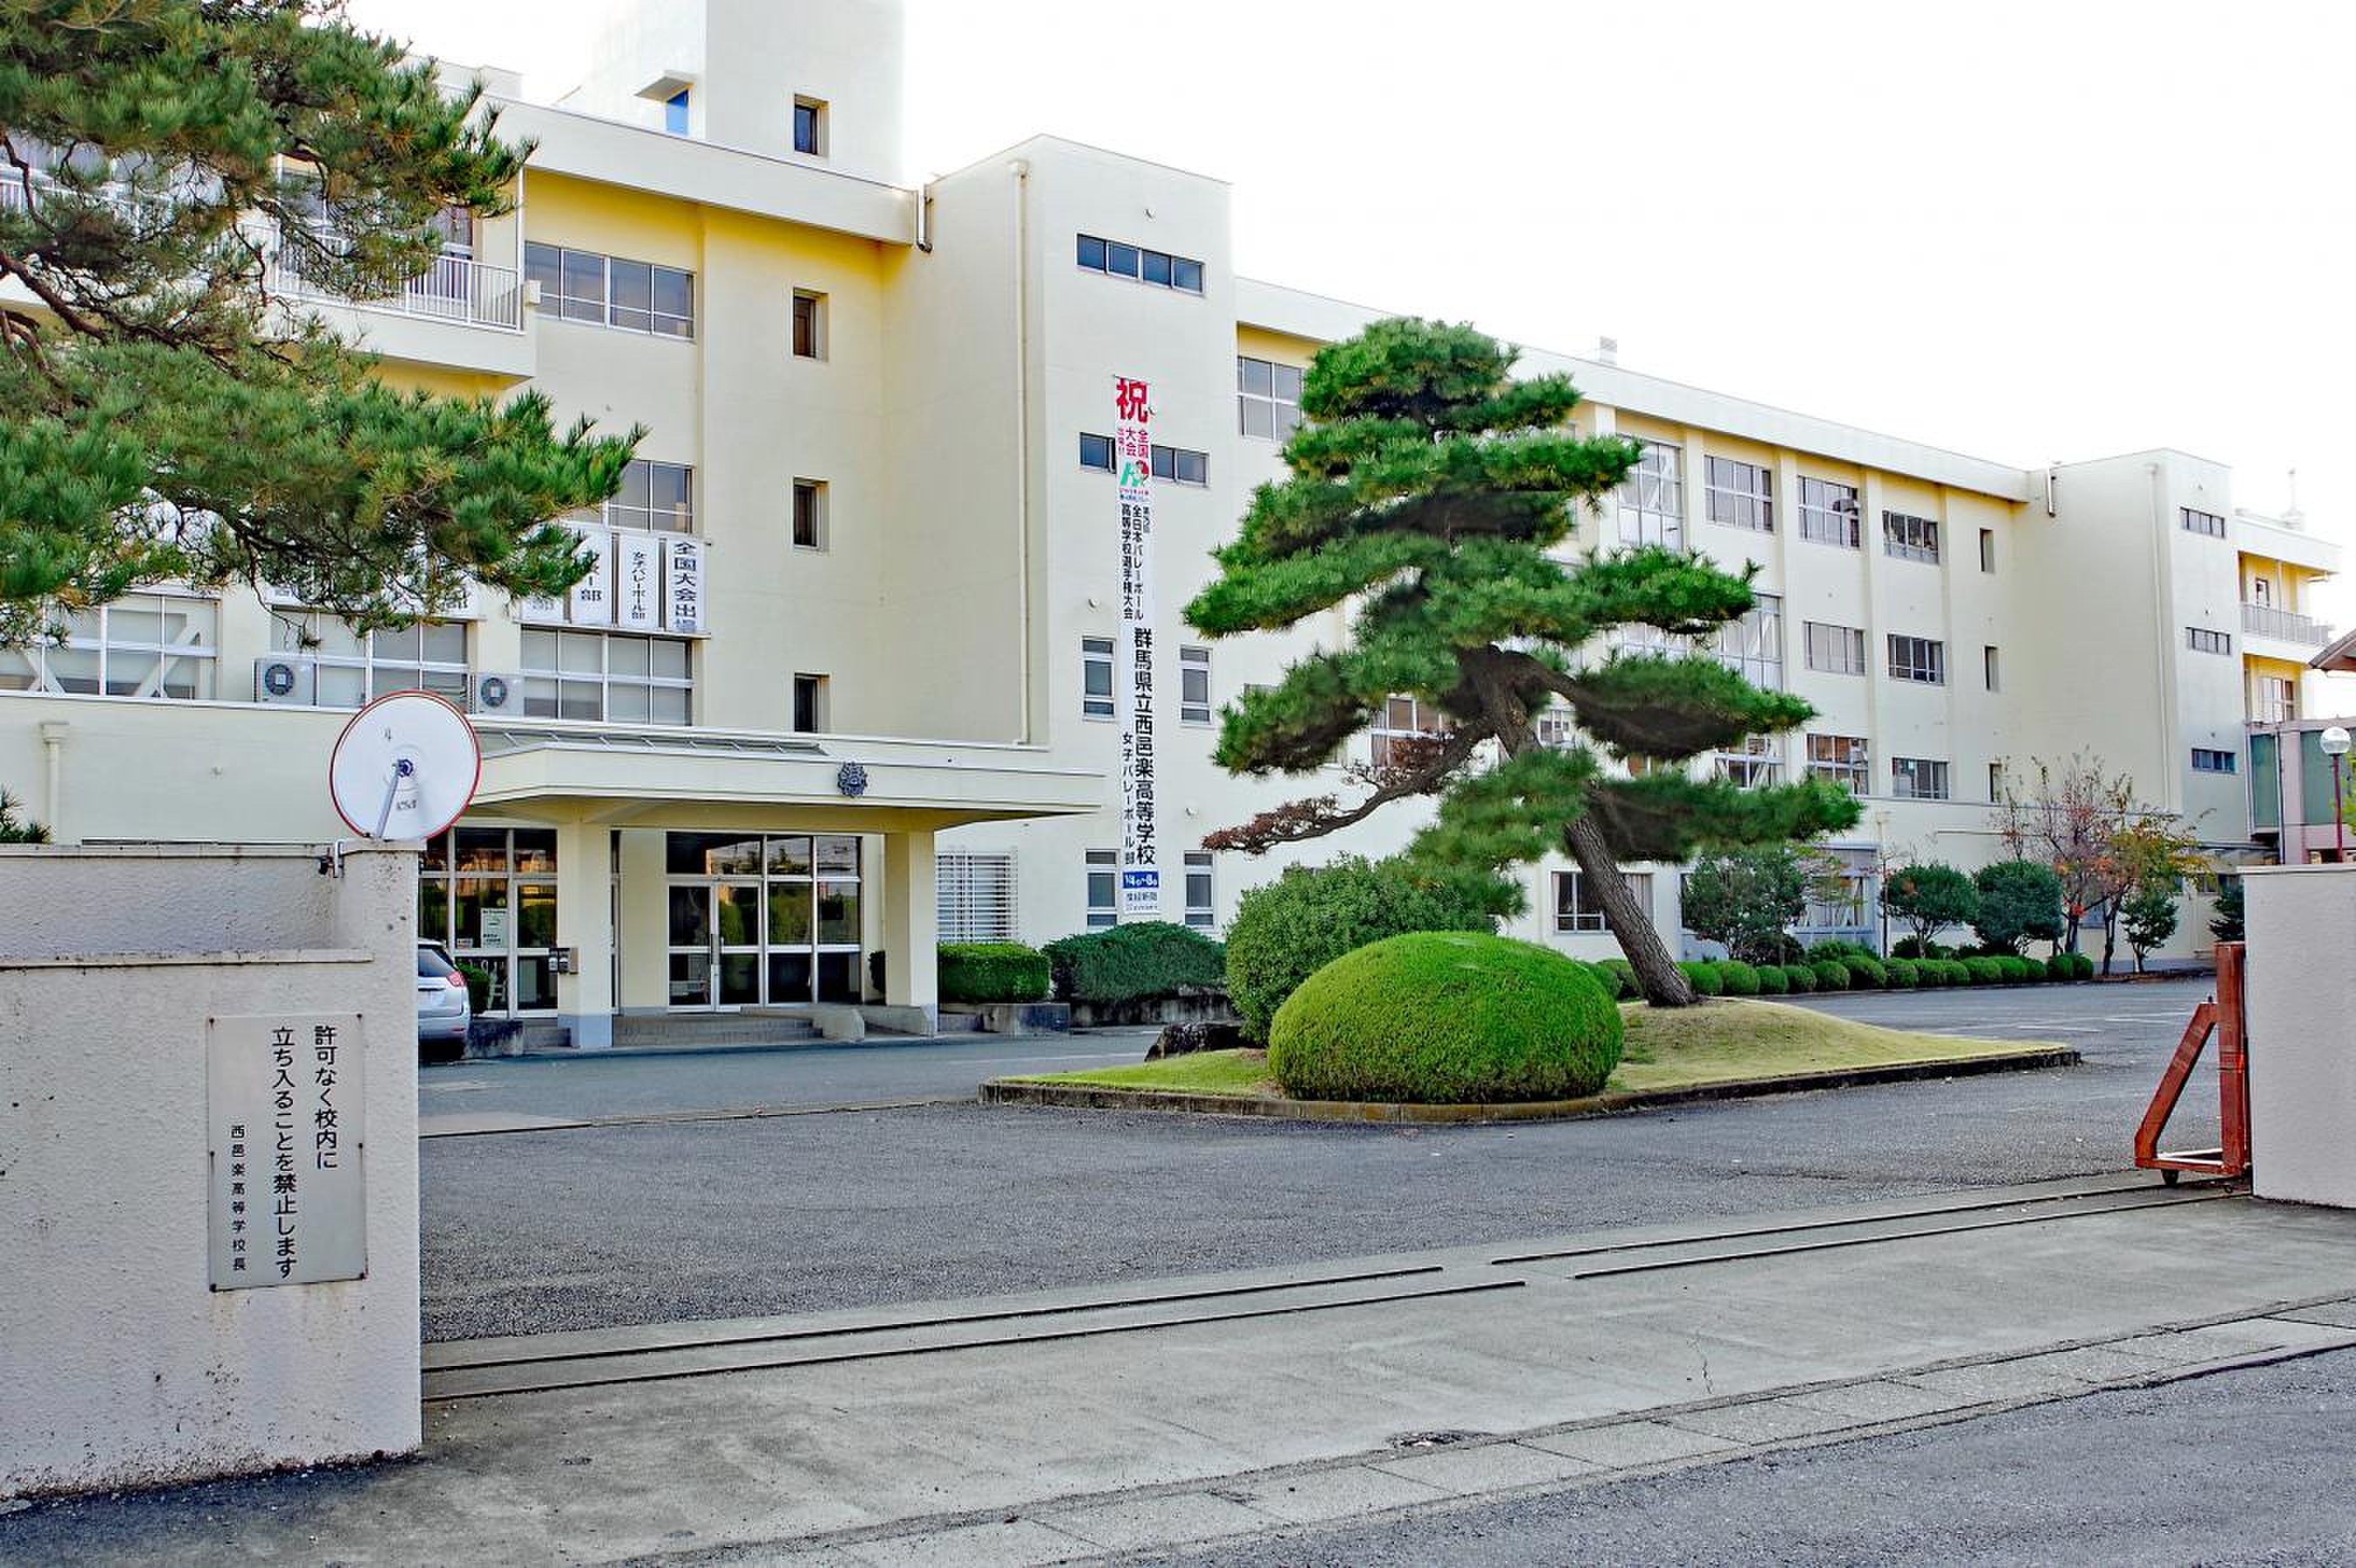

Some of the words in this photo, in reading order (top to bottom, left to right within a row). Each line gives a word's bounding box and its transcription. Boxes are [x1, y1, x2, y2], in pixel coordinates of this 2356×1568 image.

[1116, 378, 1148, 423] 祝
[1126, 427, 1136, 456] 大会
[1122, 732, 1134, 865] 女子バレーボール部
[1134, 627, 1155, 865] 群馬県立西邑楽高等学校
[271, 1025, 297, 1280] 立ち入ることを禁止します
[314, 1024, 338, 1171] 許可なく校内に
[230, 1124, 247, 1272] 西邑楽高等学校長
